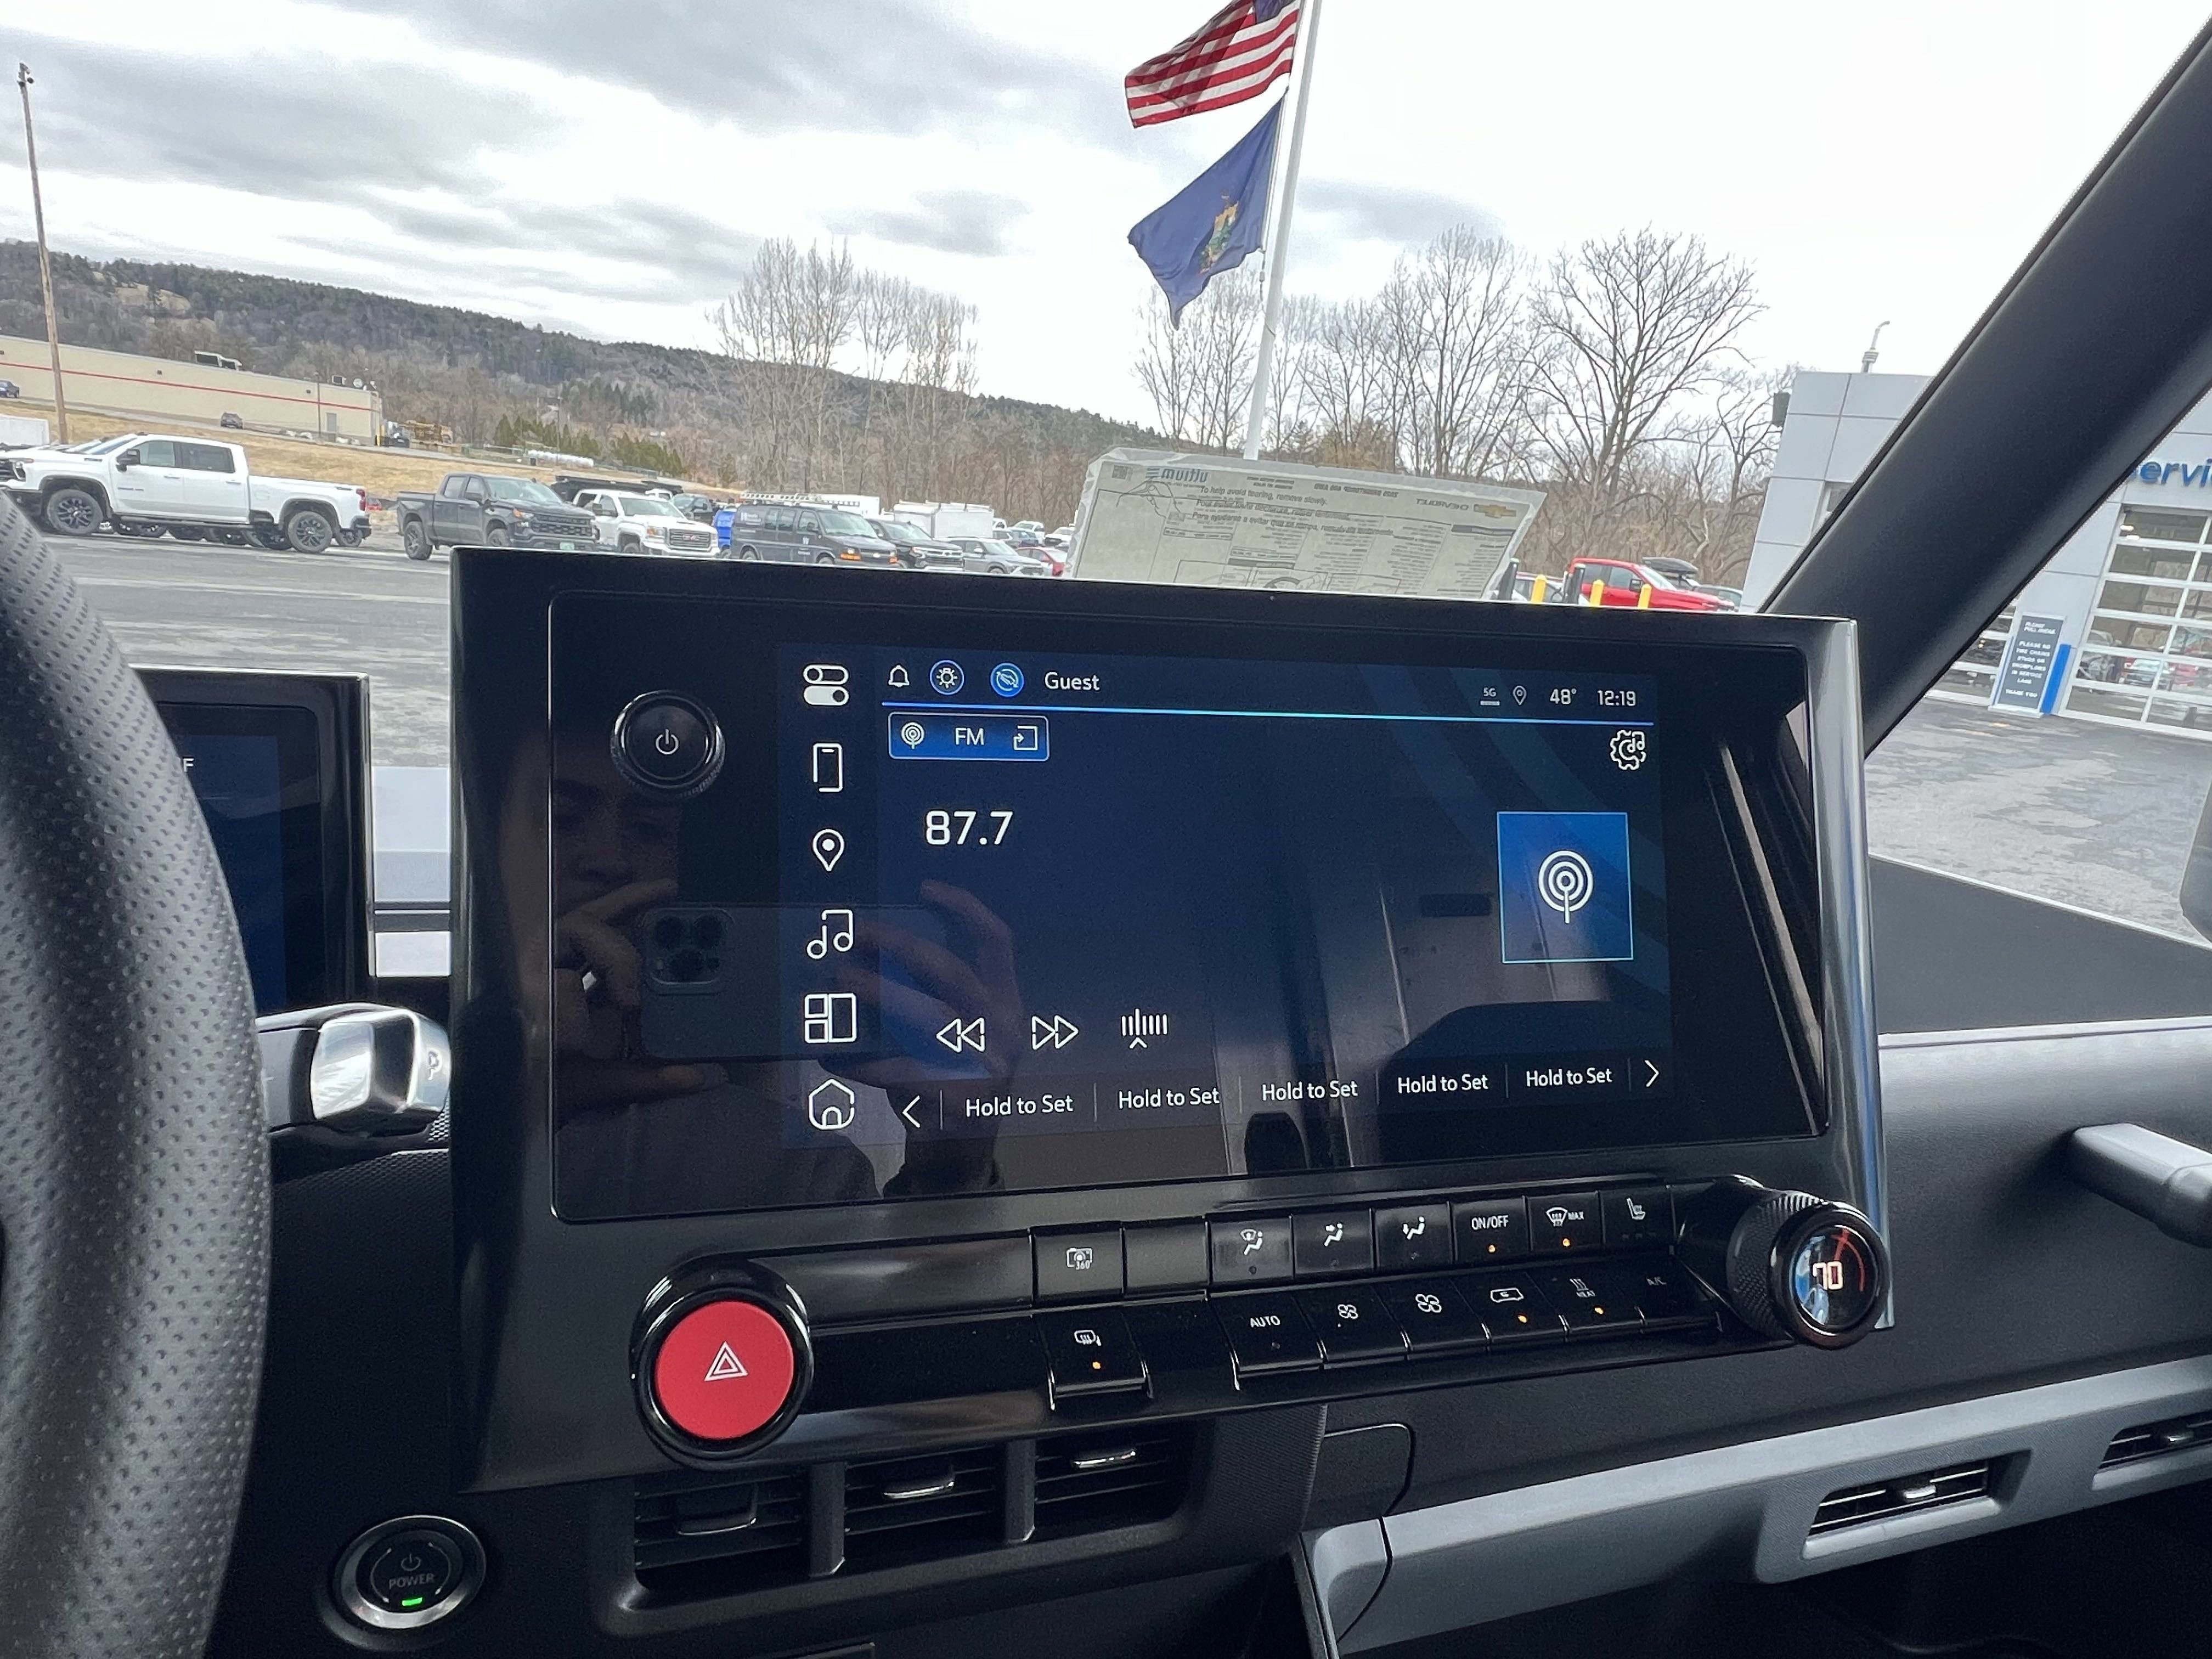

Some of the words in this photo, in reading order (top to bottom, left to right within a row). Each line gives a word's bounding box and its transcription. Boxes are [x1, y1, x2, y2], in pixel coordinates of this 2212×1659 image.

[1210, 487, 1226, 495] help
[1248, 490, 1273, 500] tearing,
[1276, 493, 1302, 503] remove
[1045, 672, 1099, 691] Guest
[1483, 687, 1497, 697] 5G
[1549, 688, 1577, 704] 48°
[1598, 690, 1636, 706] 12:19
[955, 727, 984, 745] FM
[926, 811, 1013, 845] 87.7
[1398, 1075, 1436, 1094] Hold
[1440, 1076, 1458, 1092] to
[1462, 1074, 1488, 1091] Set
[1526, 1069, 1562, 1087] Hold
[1566, 1070, 1583, 1085] to
[1587, 1068, 1612, 1084] Set
[1119, 1090, 1163, 1109] Hold
[1166, 1090, 1185, 1106] to
[1190, 1087, 1220, 1105] Set
[1262, 1081, 1302, 1101] Hold
[1307, 1083, 1325, 1098] to
[1330, 1081, 1358, 1097] Set
[966, 1097, 1012, 1117] Hold
[1016, 1097, 1036, 1114] to
[1042, 1094, 1073, 1113] Set
[1471, 1215, 1509, 1230] ON/OFF
[1568, 1211, 1584, 1220] MAX
[1812, 1261, 1843, 1291] 70
[1250, 1315, 1281, 1328] AUTO
[388, 1572, 435, 1589] POWER
